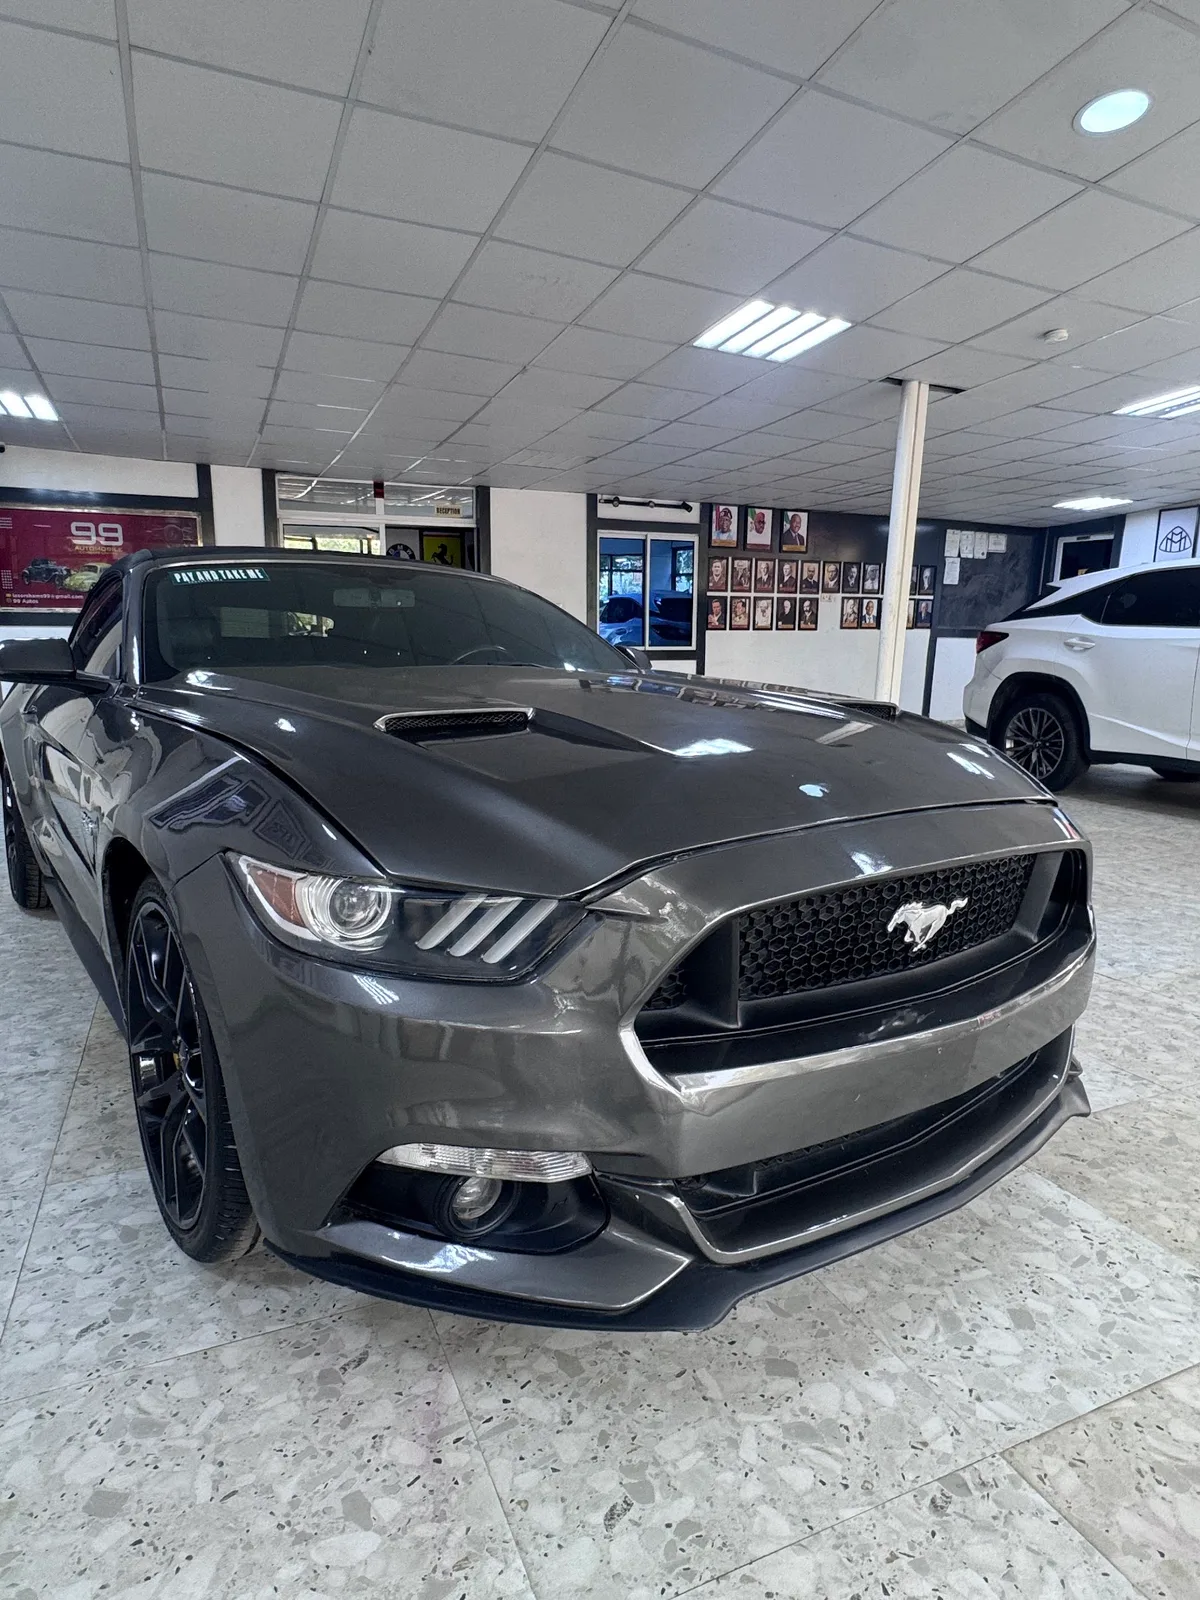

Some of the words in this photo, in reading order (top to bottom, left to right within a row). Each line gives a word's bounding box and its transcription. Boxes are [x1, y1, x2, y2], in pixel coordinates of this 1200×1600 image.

[436, 507, 461, 515] RECEPTION
[70, 521, 124, 547] 99
[174, 572, 195, 583] PAY
[196, 570, 219, 581] AND
[218, 569, 248, 580] TAKE
[246, 568, 264, 579] ME
